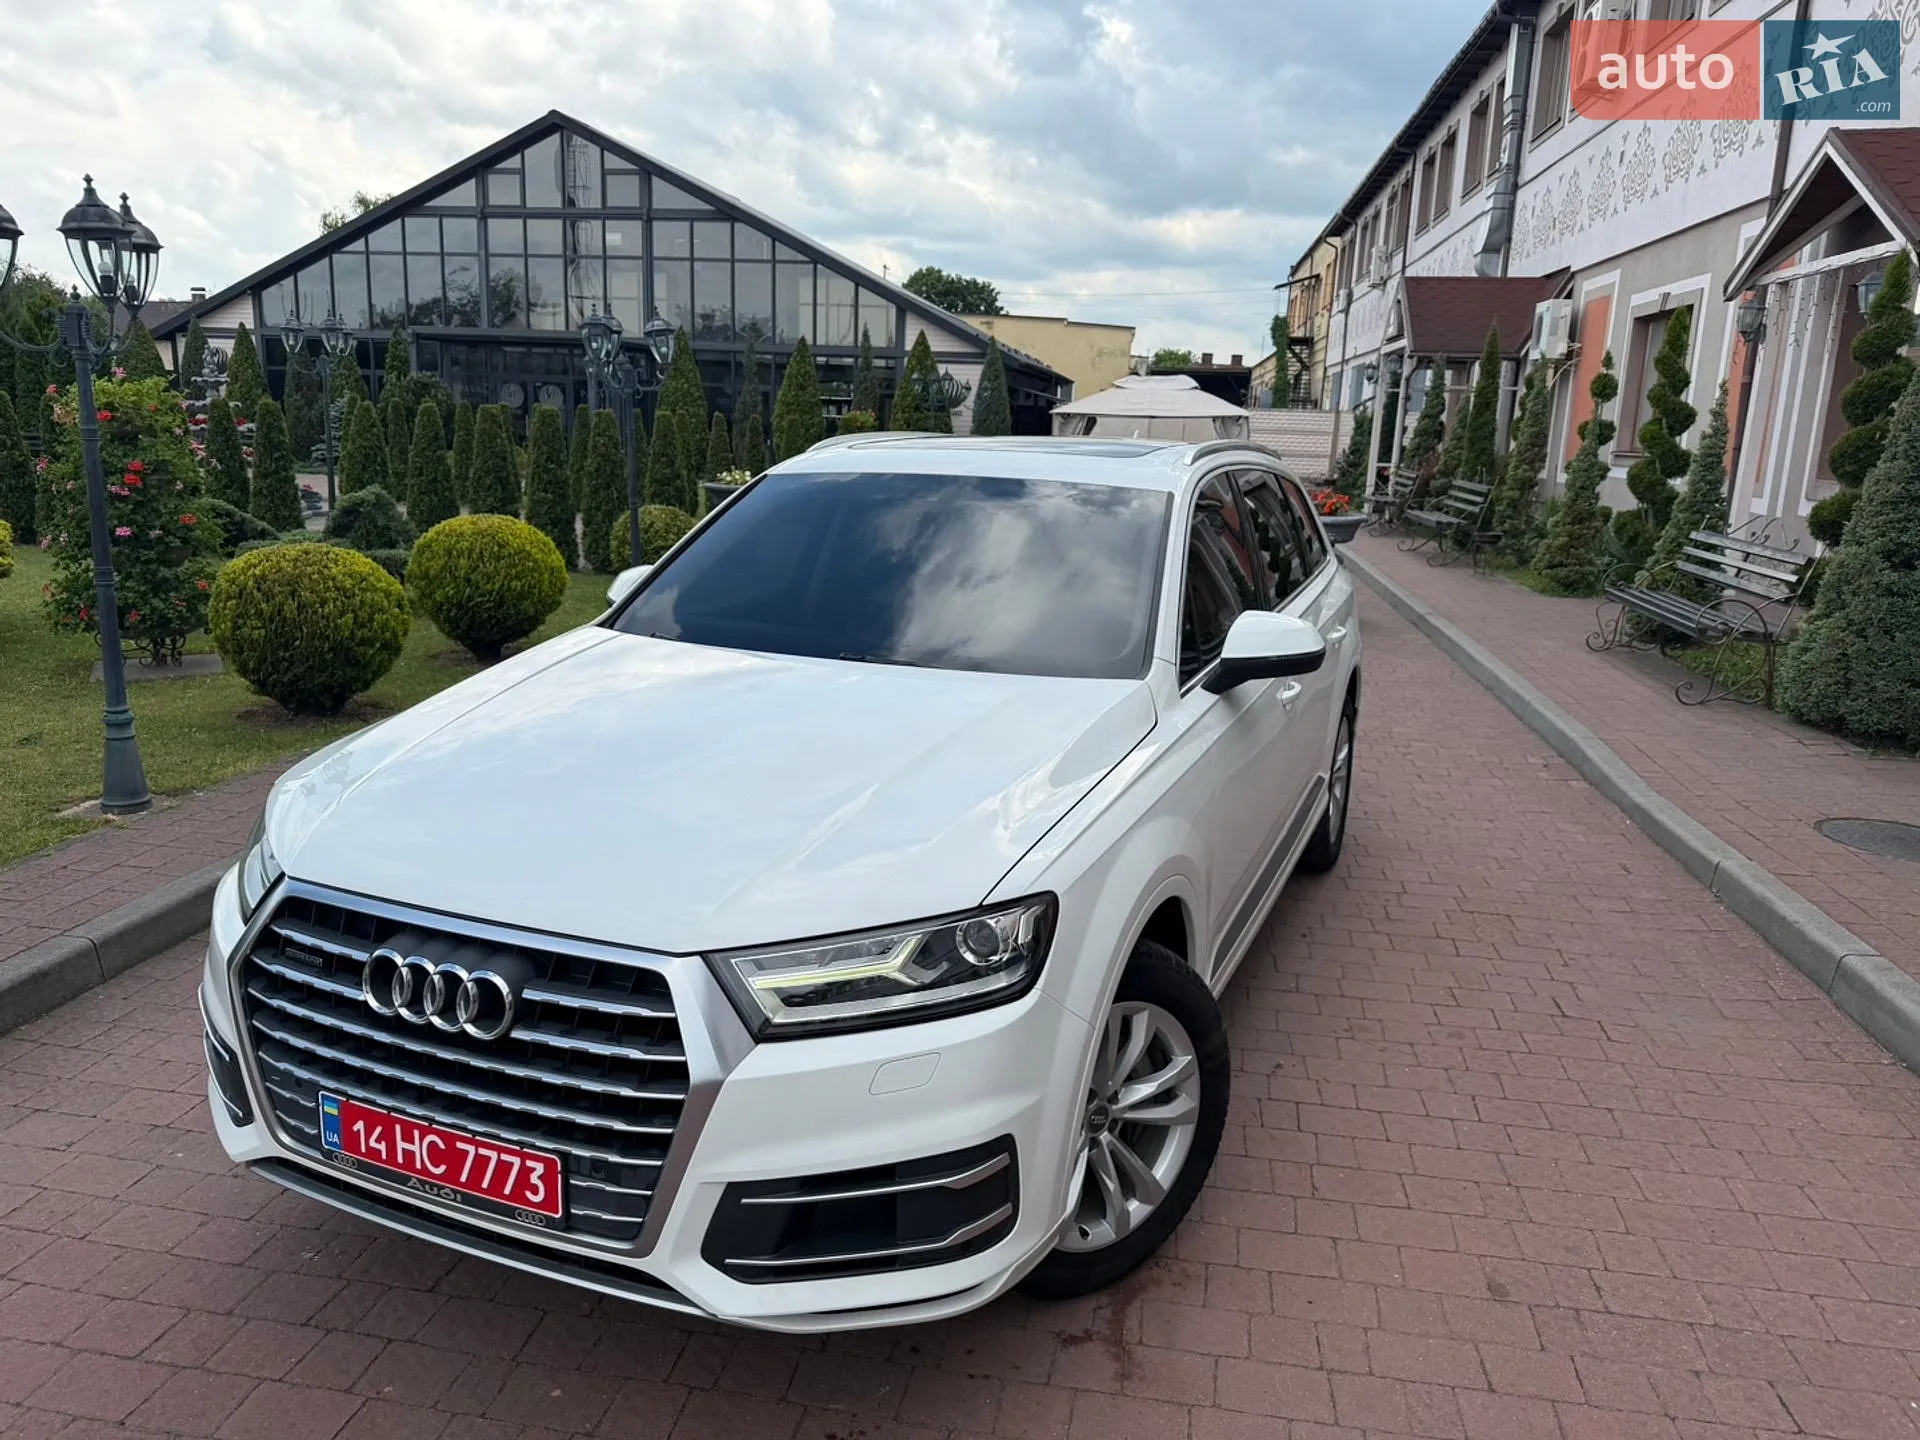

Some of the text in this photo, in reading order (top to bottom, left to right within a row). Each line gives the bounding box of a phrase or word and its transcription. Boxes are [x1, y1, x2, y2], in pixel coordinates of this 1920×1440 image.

[326, 1131, 340, 1144] UA
[352, 1119, 546, 1203] 14 HC 7773
